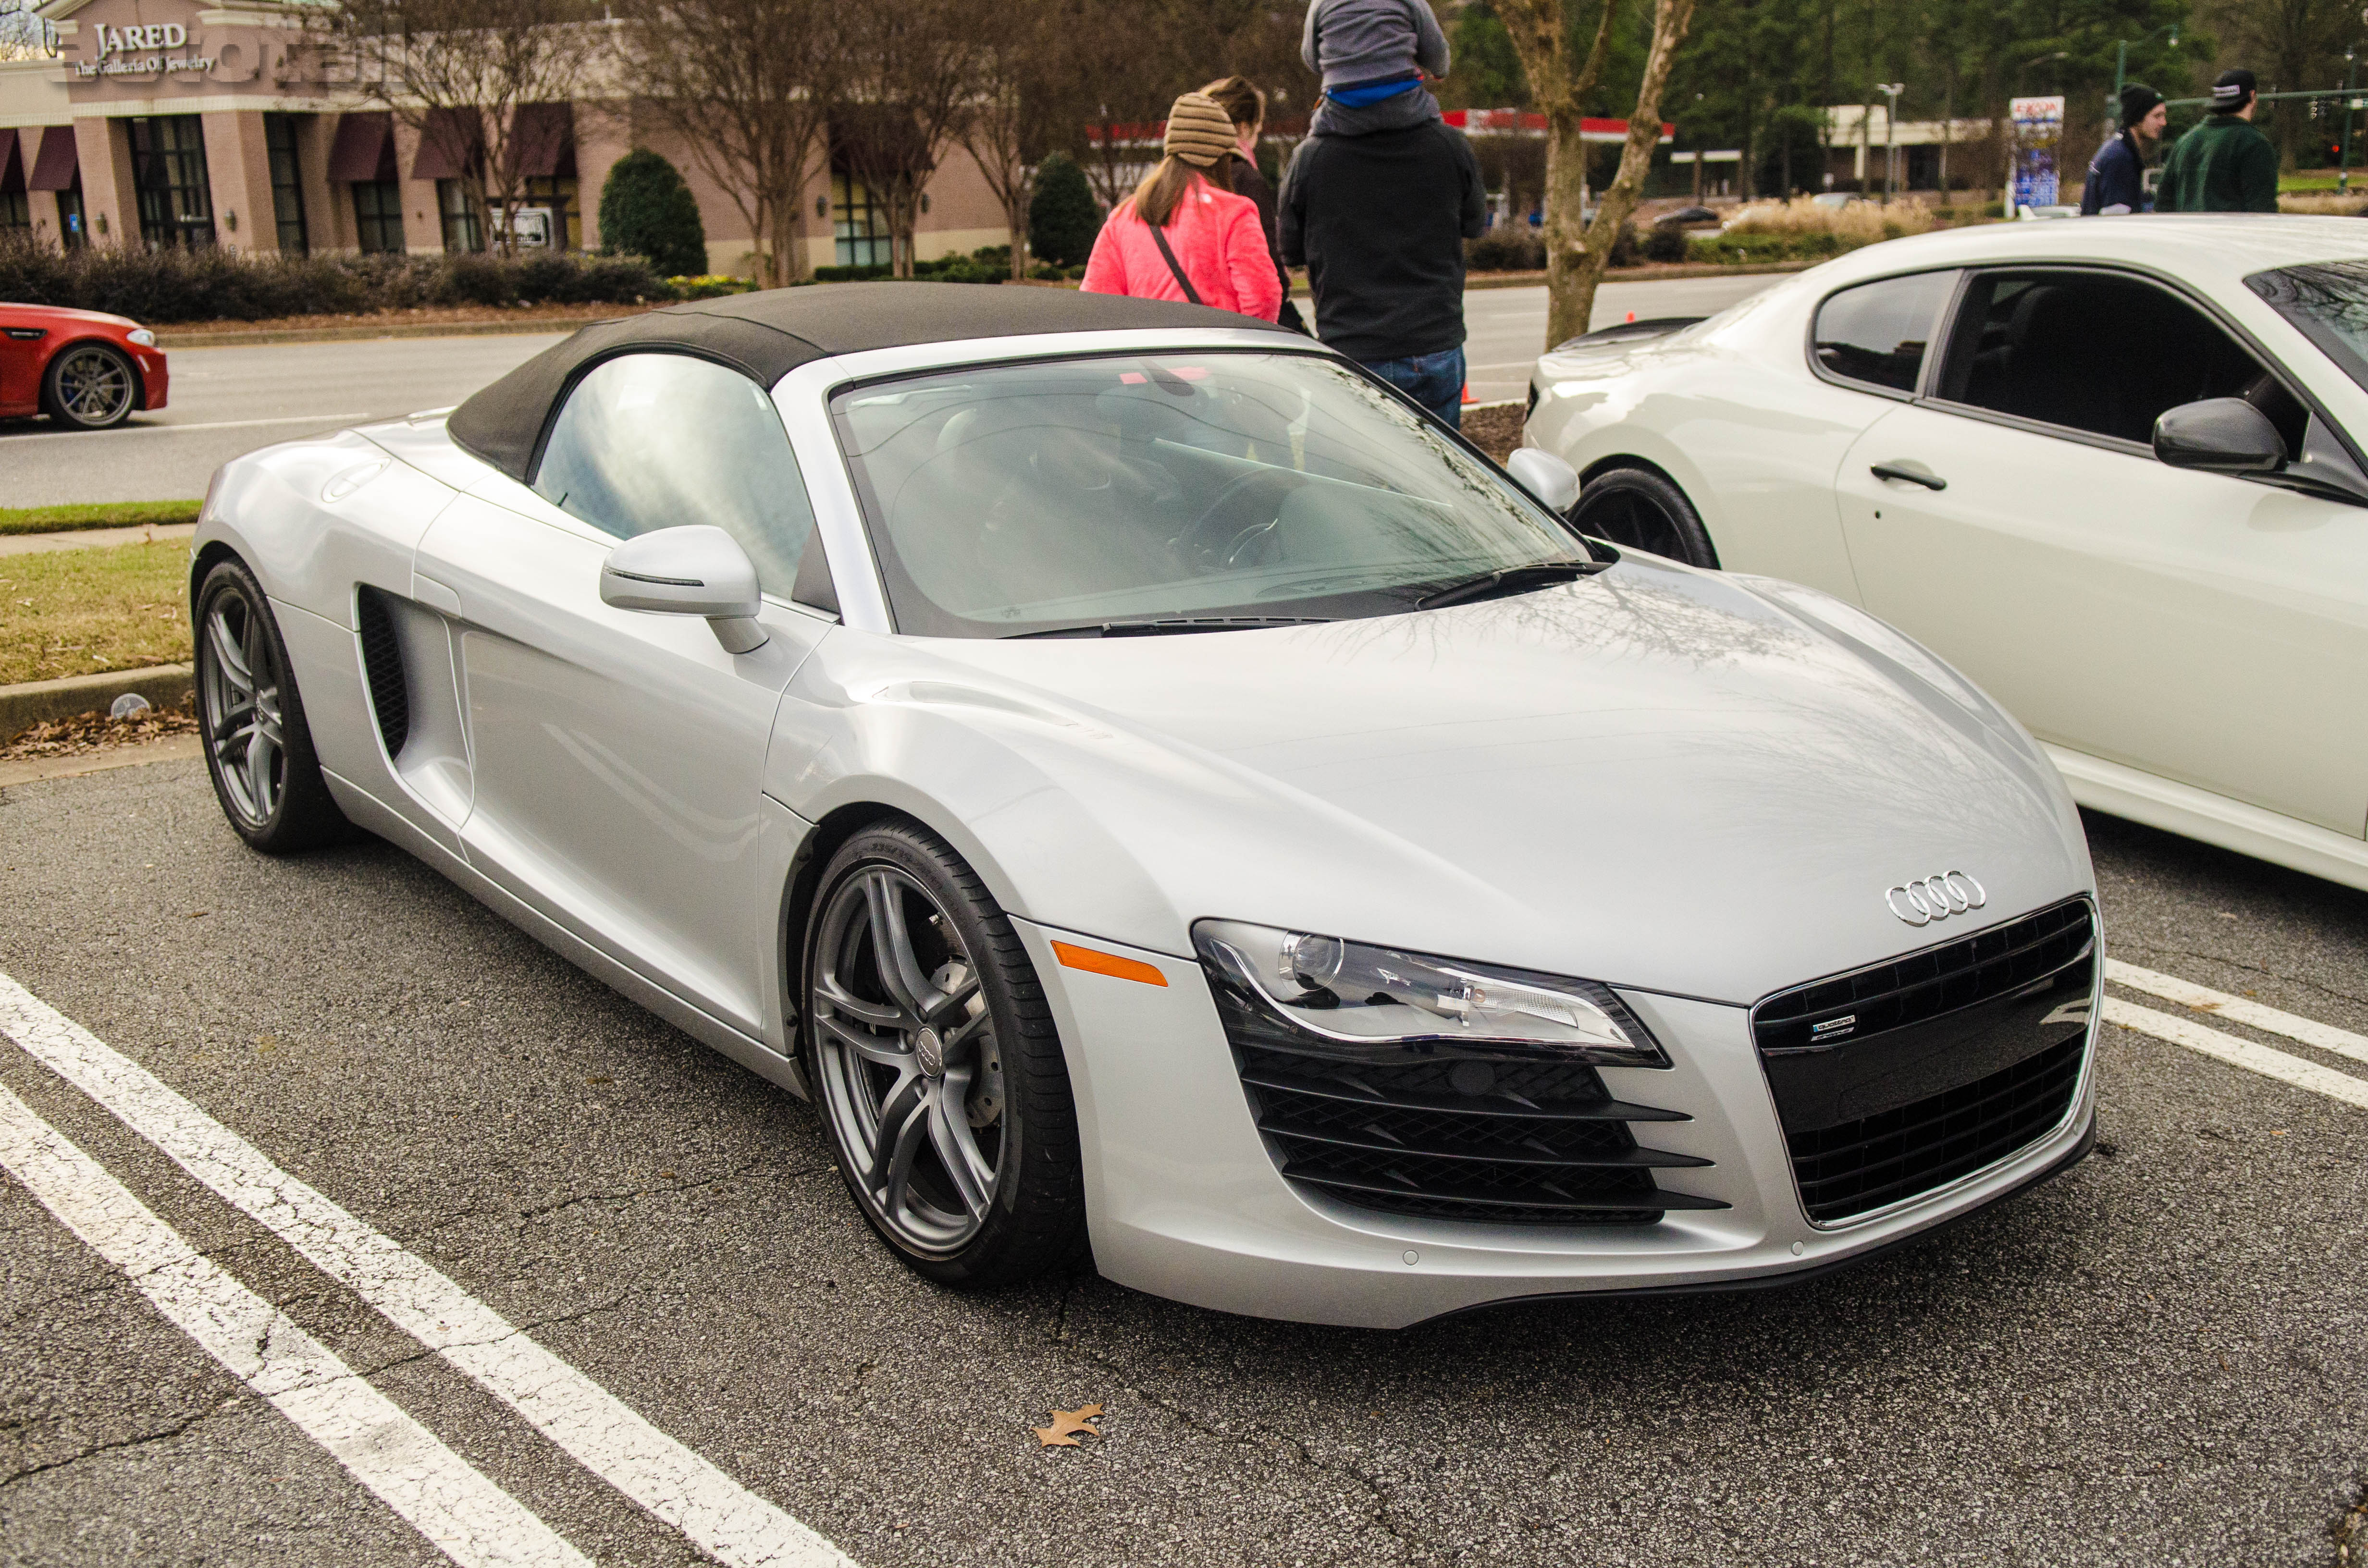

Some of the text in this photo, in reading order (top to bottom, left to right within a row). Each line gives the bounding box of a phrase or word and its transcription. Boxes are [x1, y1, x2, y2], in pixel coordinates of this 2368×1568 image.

[94, 23, 187, 61] JARED
[74, 60, 97, 75] The
[98, 58, 146, 74] Galleria
[166, 54, 216, 74] Jewelry
[1818, 1018, 1851, 1029] quattro
